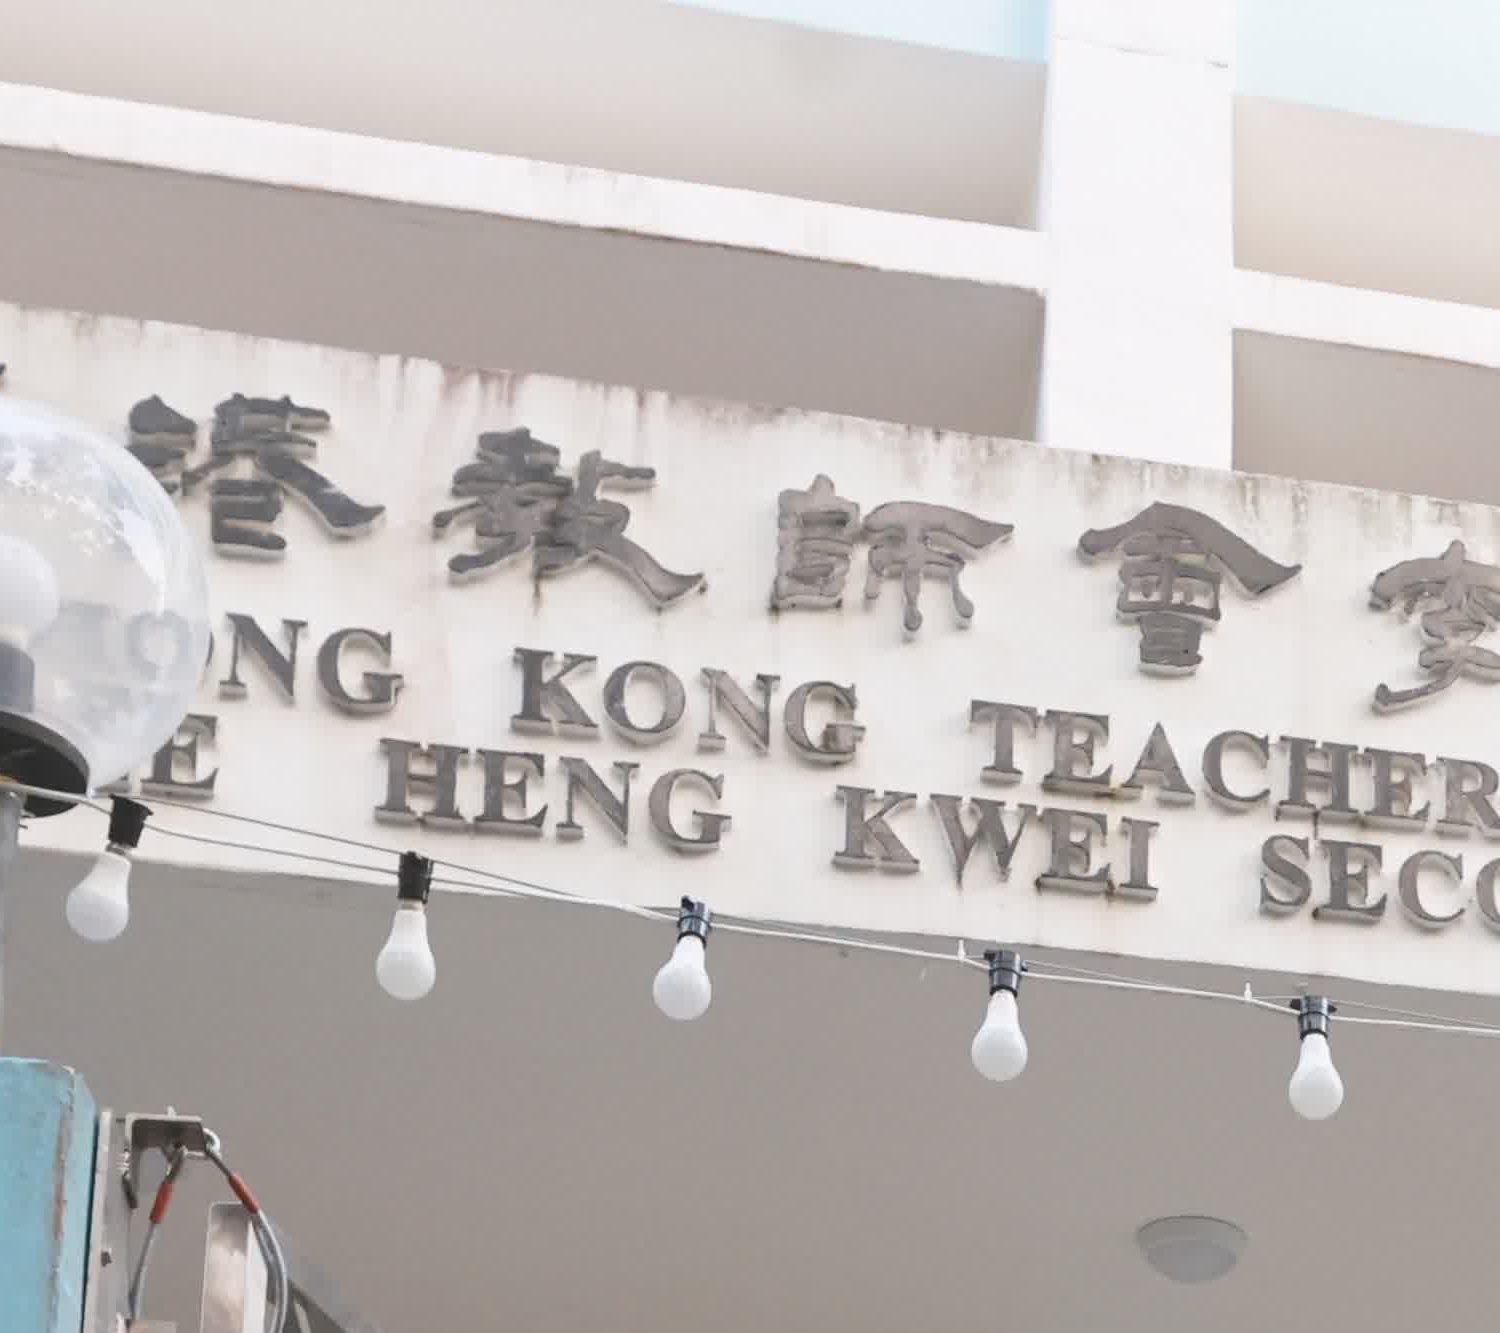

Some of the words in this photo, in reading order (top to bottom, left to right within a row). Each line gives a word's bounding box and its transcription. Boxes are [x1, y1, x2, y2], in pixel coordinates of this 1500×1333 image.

[512, 645, 867, 766] KONG
[373, 738, 732, 854] HENG
[831, 785, 1162, 902] KWEI
